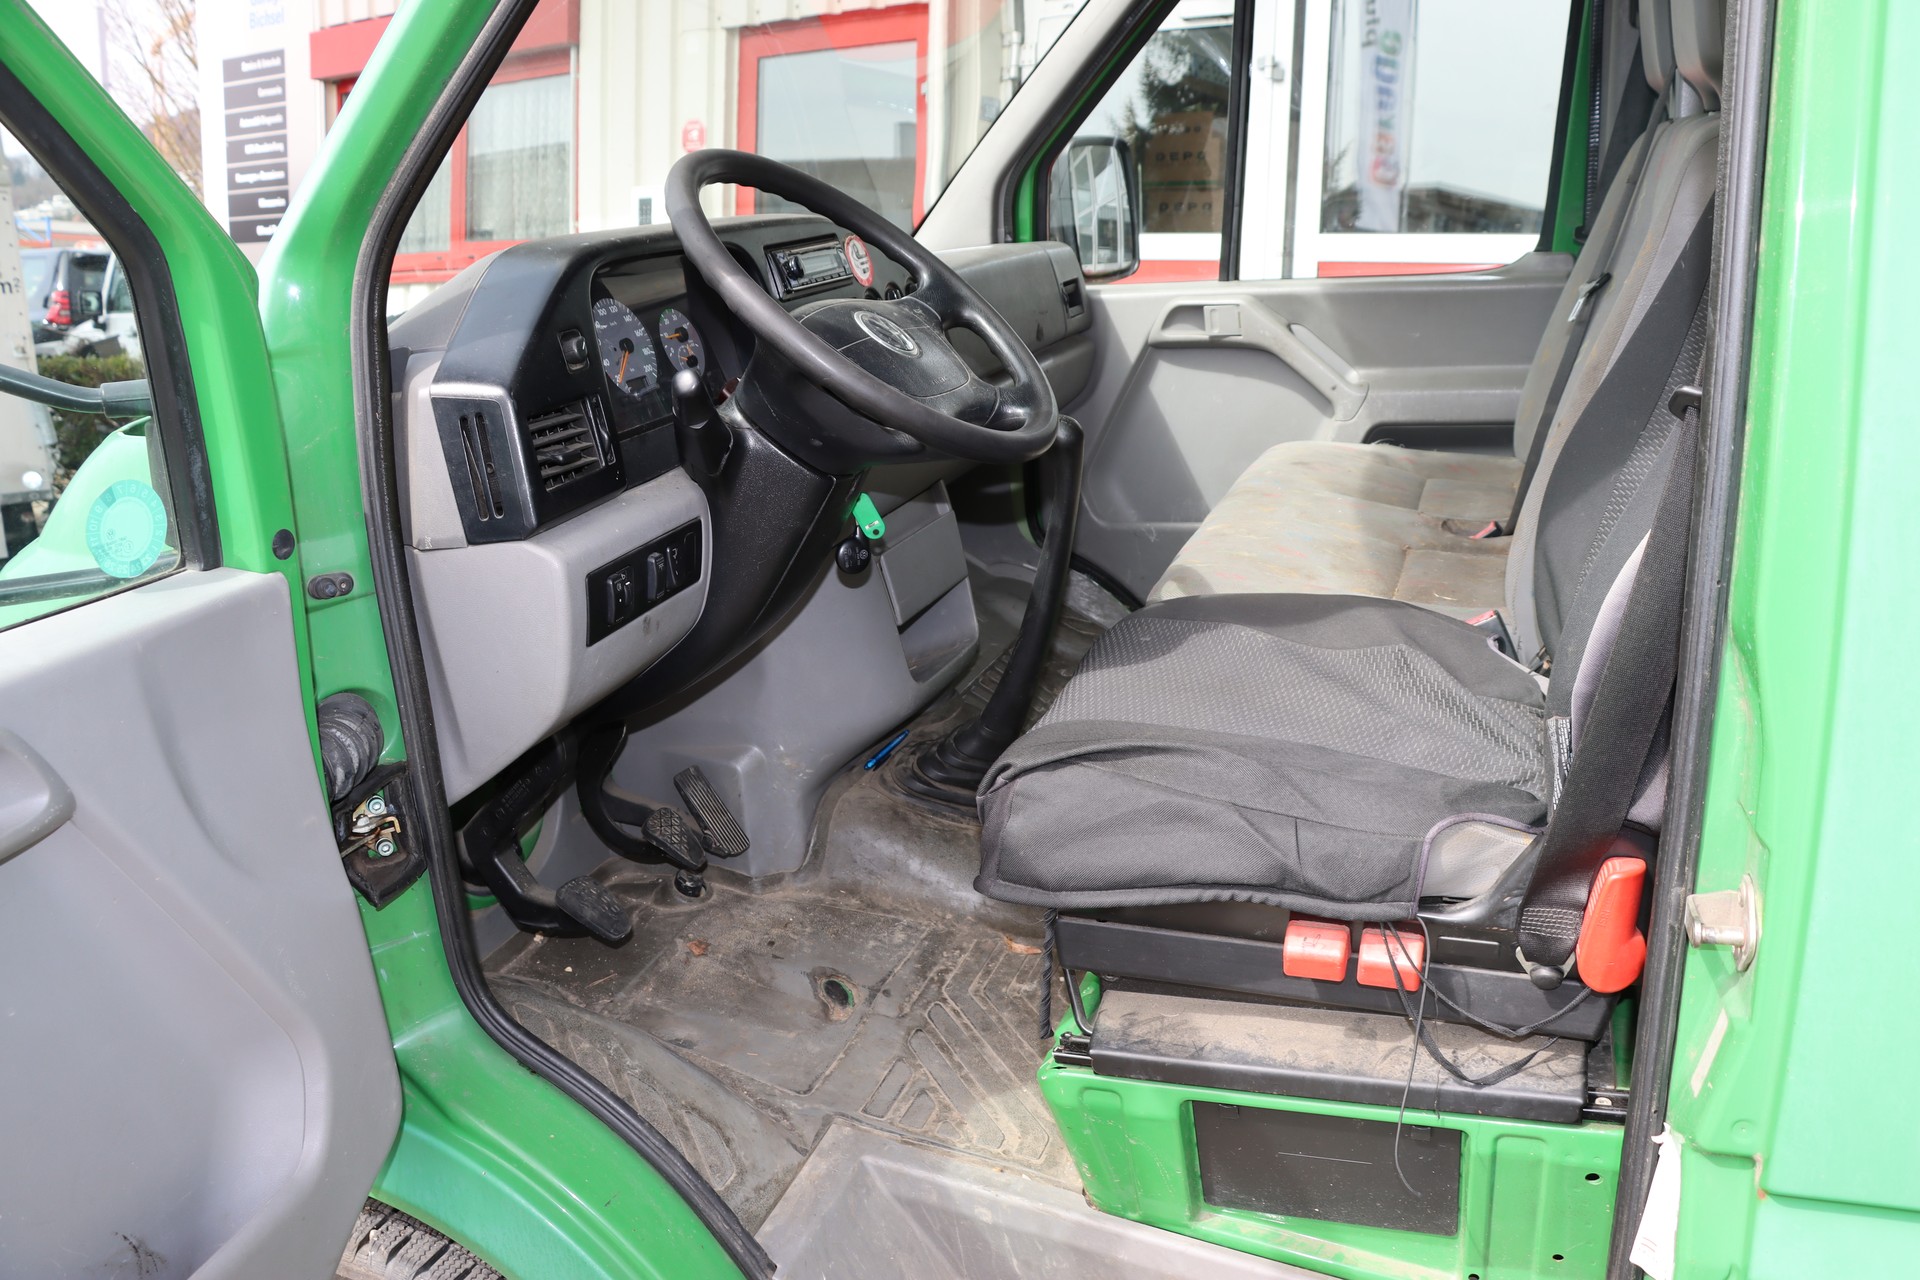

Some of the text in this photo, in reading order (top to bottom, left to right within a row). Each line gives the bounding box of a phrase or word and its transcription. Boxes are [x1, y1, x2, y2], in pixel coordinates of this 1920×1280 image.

[1155, 151, 1206, 161] DEPO
[1159, 201, 1212, 213] DEPO
[597, 308, 607, 316] 100
[609, 305, 618, 313] 120
[634, 329, 643, 337] 160
[644, 364, 652, 372] 200
